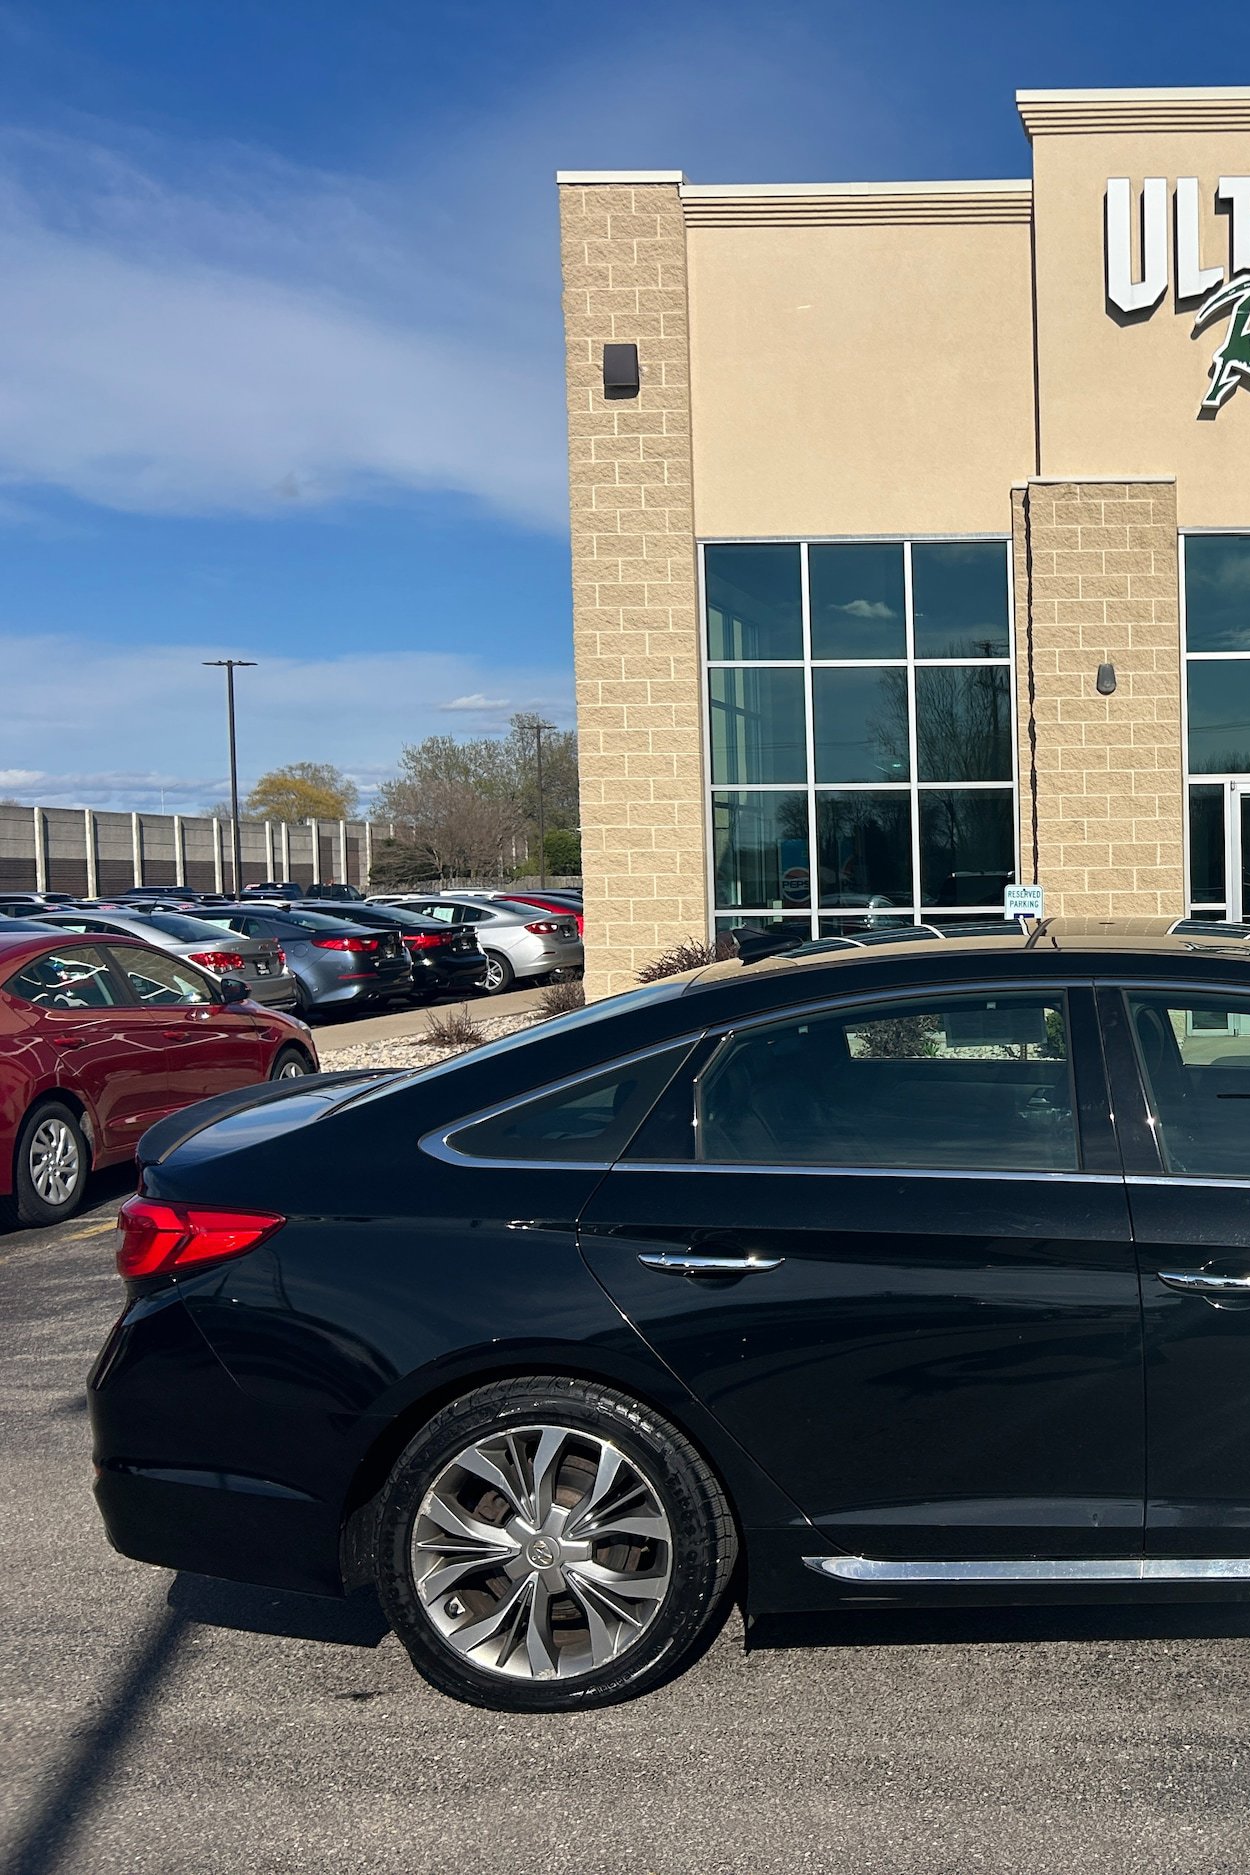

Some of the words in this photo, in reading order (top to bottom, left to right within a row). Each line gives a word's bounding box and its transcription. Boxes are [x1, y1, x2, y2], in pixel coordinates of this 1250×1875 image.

[782, 880, 809, 889] PEPS
[1007, 890, 1041, 898] RESERVED
[1009, 900, 1039, 908] PARKING
